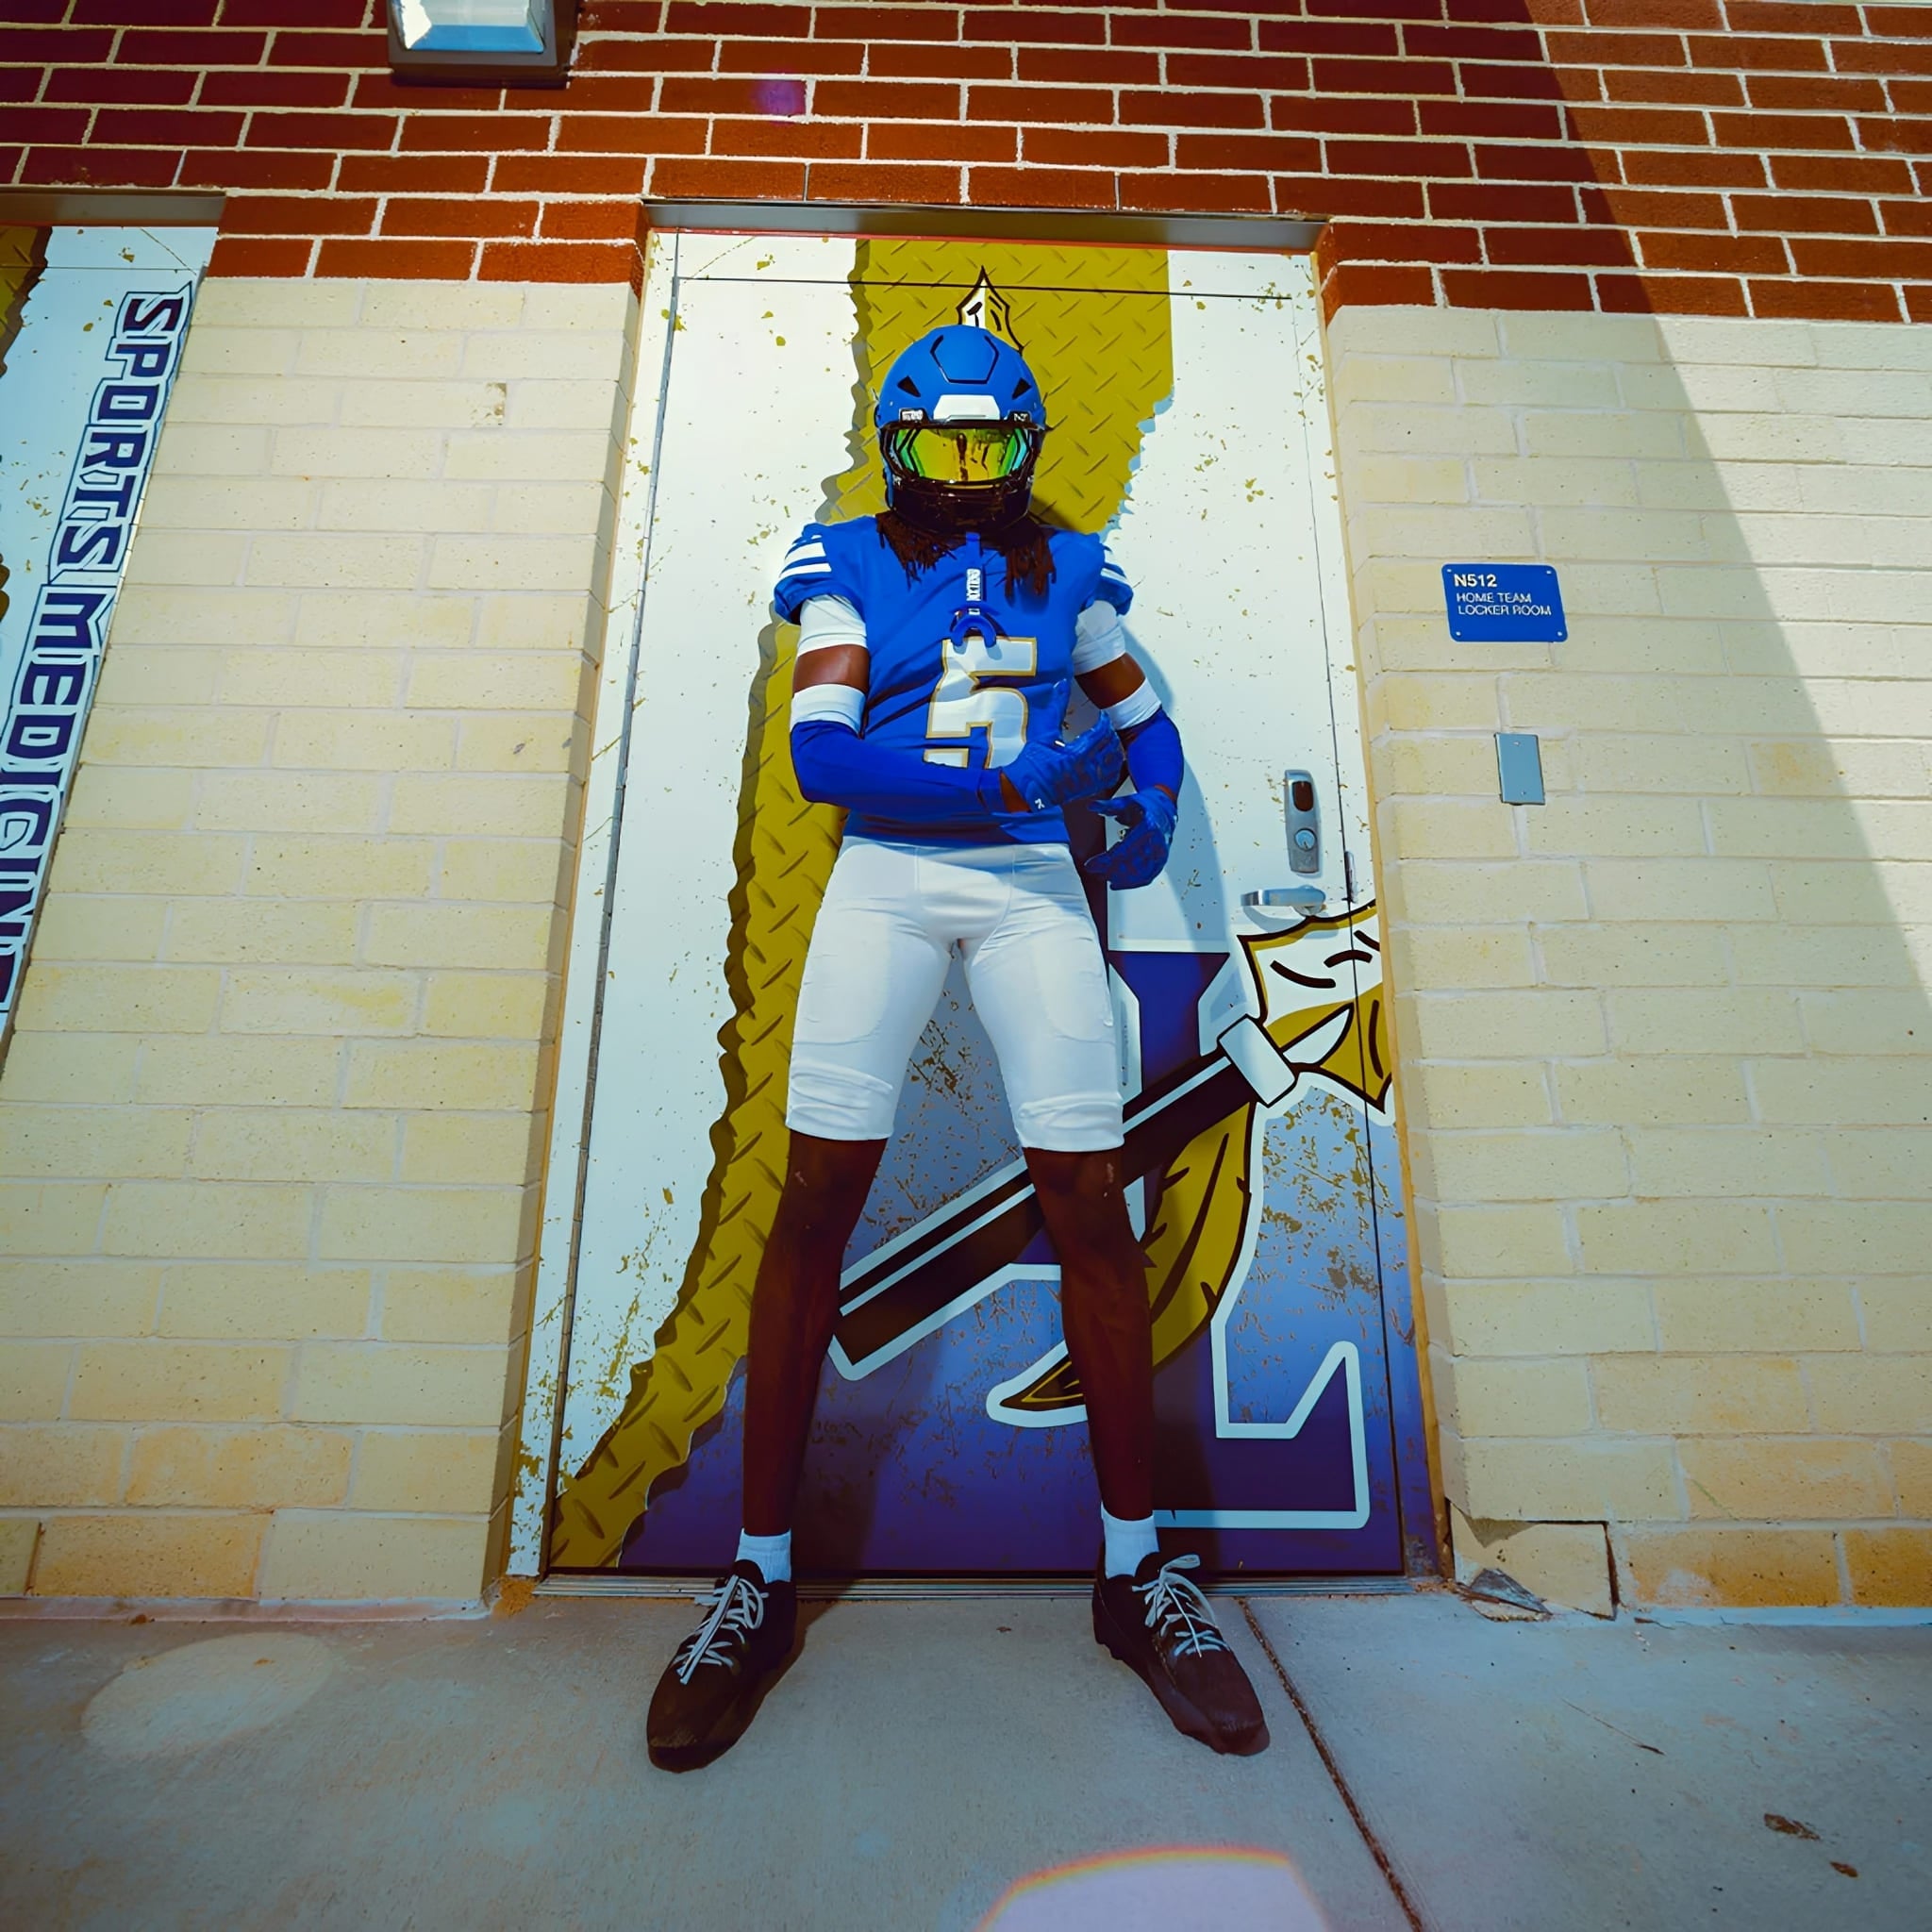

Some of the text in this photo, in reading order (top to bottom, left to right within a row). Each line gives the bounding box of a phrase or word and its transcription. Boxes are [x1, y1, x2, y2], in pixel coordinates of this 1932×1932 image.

[1453, 574, 1498, 588] N512
[1456, 591, 1532, 604] HOME TEAM
[1457, 604, 1552, 616] LOCKER ROOM
[0, 291, 189, 1005] SPORTS MEDICI
[923, 636, 1038, 770] 5
